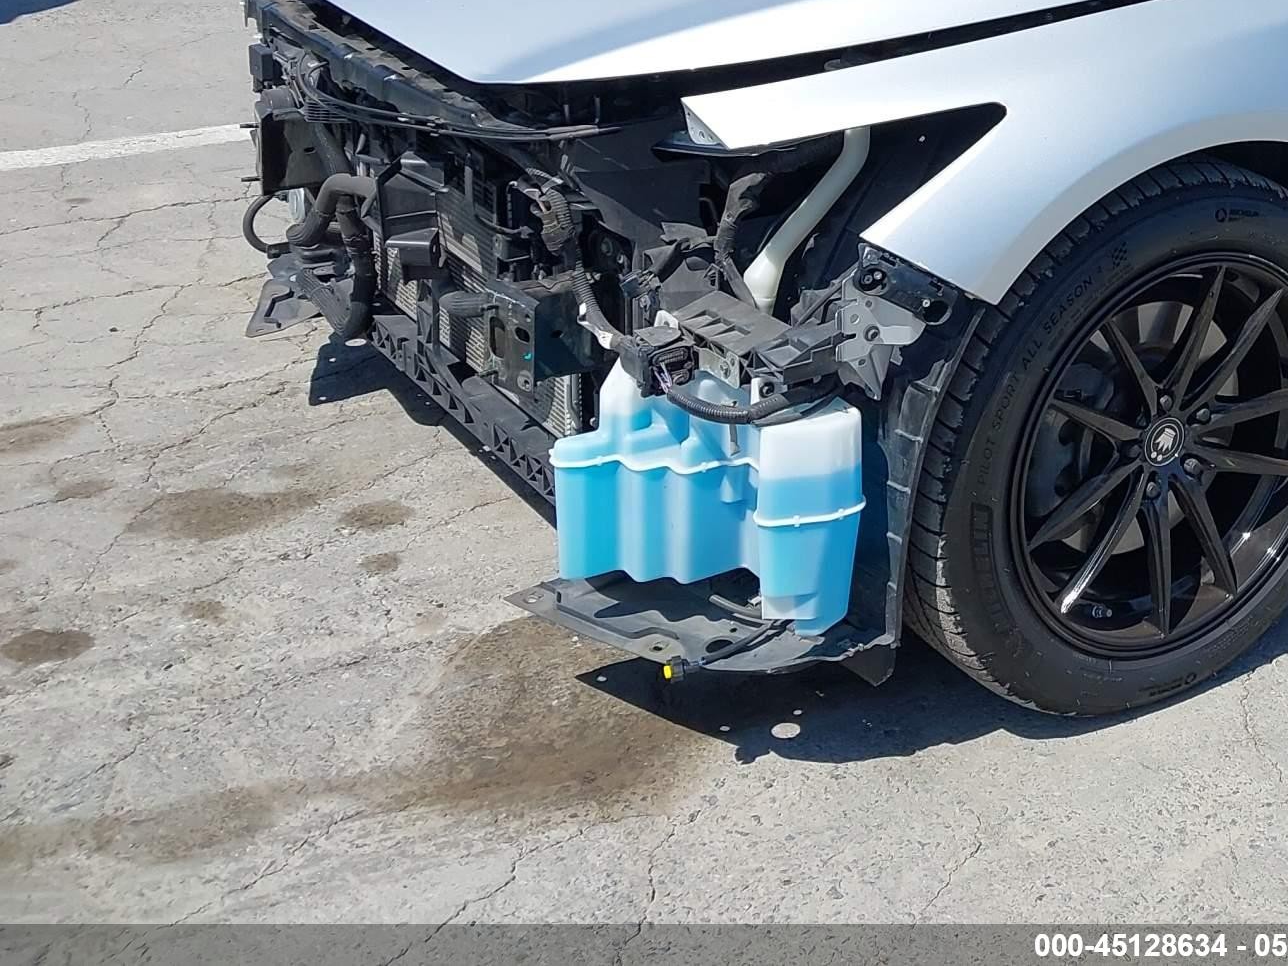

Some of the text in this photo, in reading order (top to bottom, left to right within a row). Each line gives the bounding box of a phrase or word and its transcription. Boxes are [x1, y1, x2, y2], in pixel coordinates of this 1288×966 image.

[977, 438, 996, 486] PILOT
[991, 372, 1019, 431] SPORT
[1022, 339, 1043, 372] ALL
[1042, 276, 1094, 335] SEASON
